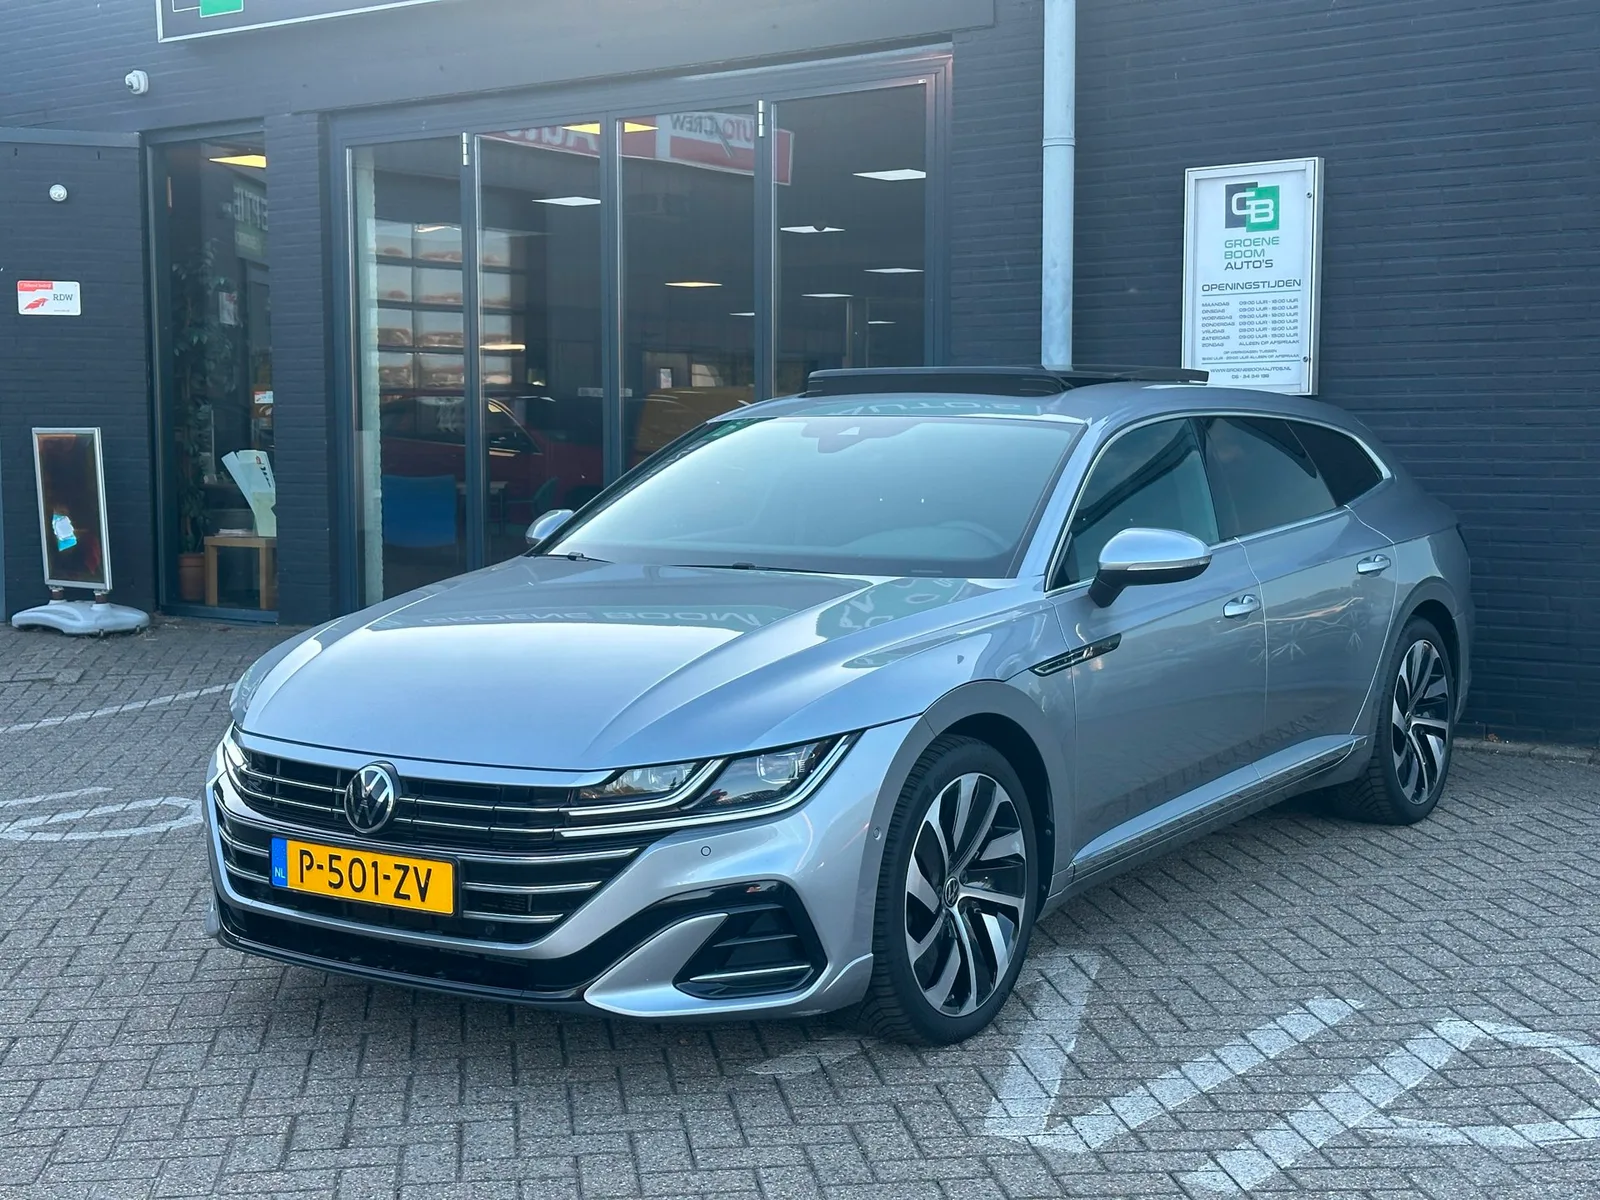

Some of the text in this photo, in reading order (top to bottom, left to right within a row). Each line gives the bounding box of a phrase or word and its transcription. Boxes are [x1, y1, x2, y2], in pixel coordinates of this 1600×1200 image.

[1224, 236, 1280, 248] GROENE
[1224, 248, 1265, 260] BOOM
[1224, 259, 1274, 270] AUTO'S
[1202, 279, 1302, 292] OPENINGSTIJDEN
[274, 866, 286, 878] NL
[299, 850, 432, 902] P-501-ZV
